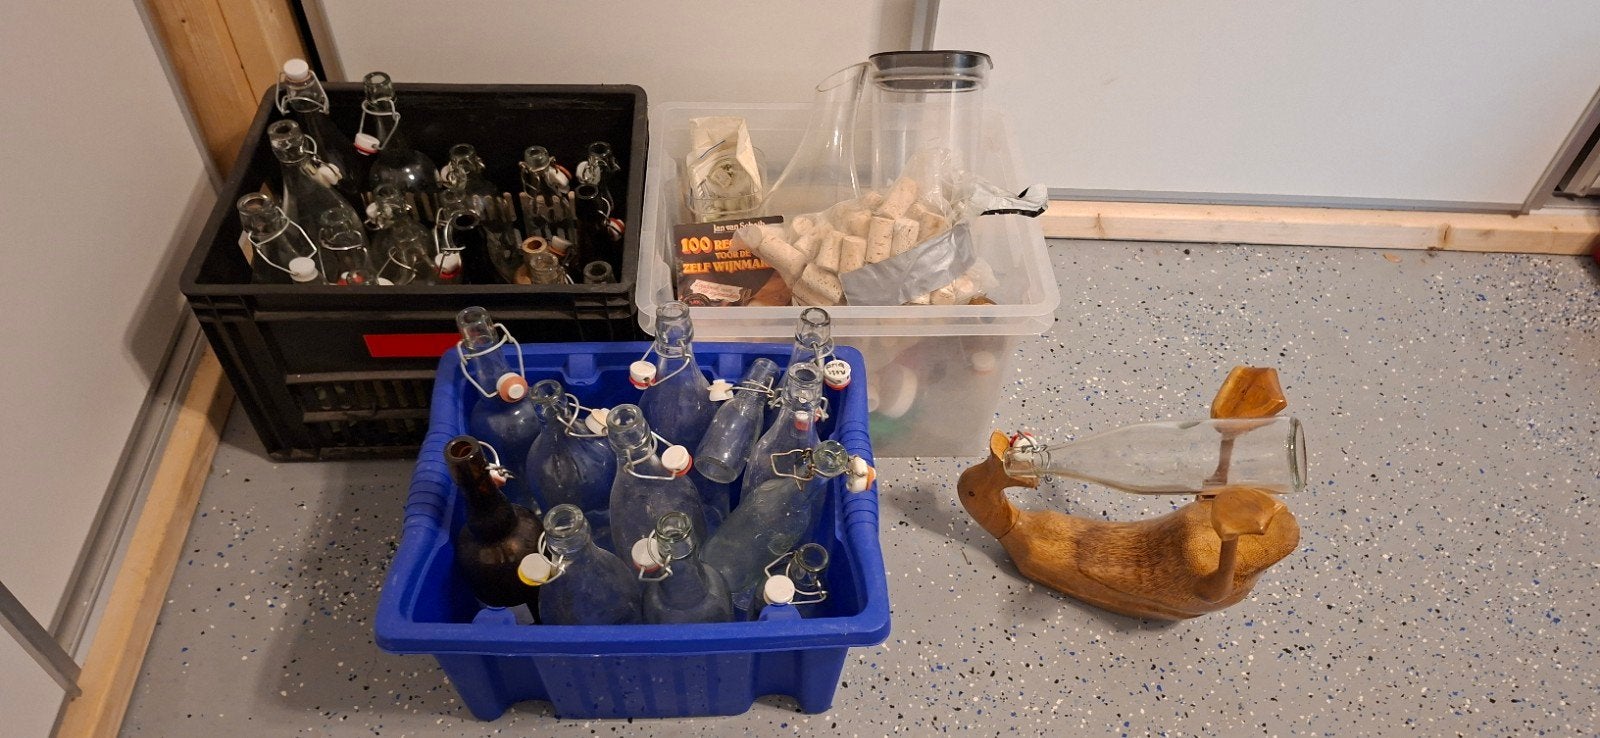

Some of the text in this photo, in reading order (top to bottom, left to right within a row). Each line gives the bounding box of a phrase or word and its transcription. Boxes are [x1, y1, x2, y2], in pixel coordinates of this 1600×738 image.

[713, 224, 725, 233] Jan
[681, 236, 714, 254] 100
[715, 250, 751, 260] VOOR DE
[682, 262, 711, 275] ZELF
